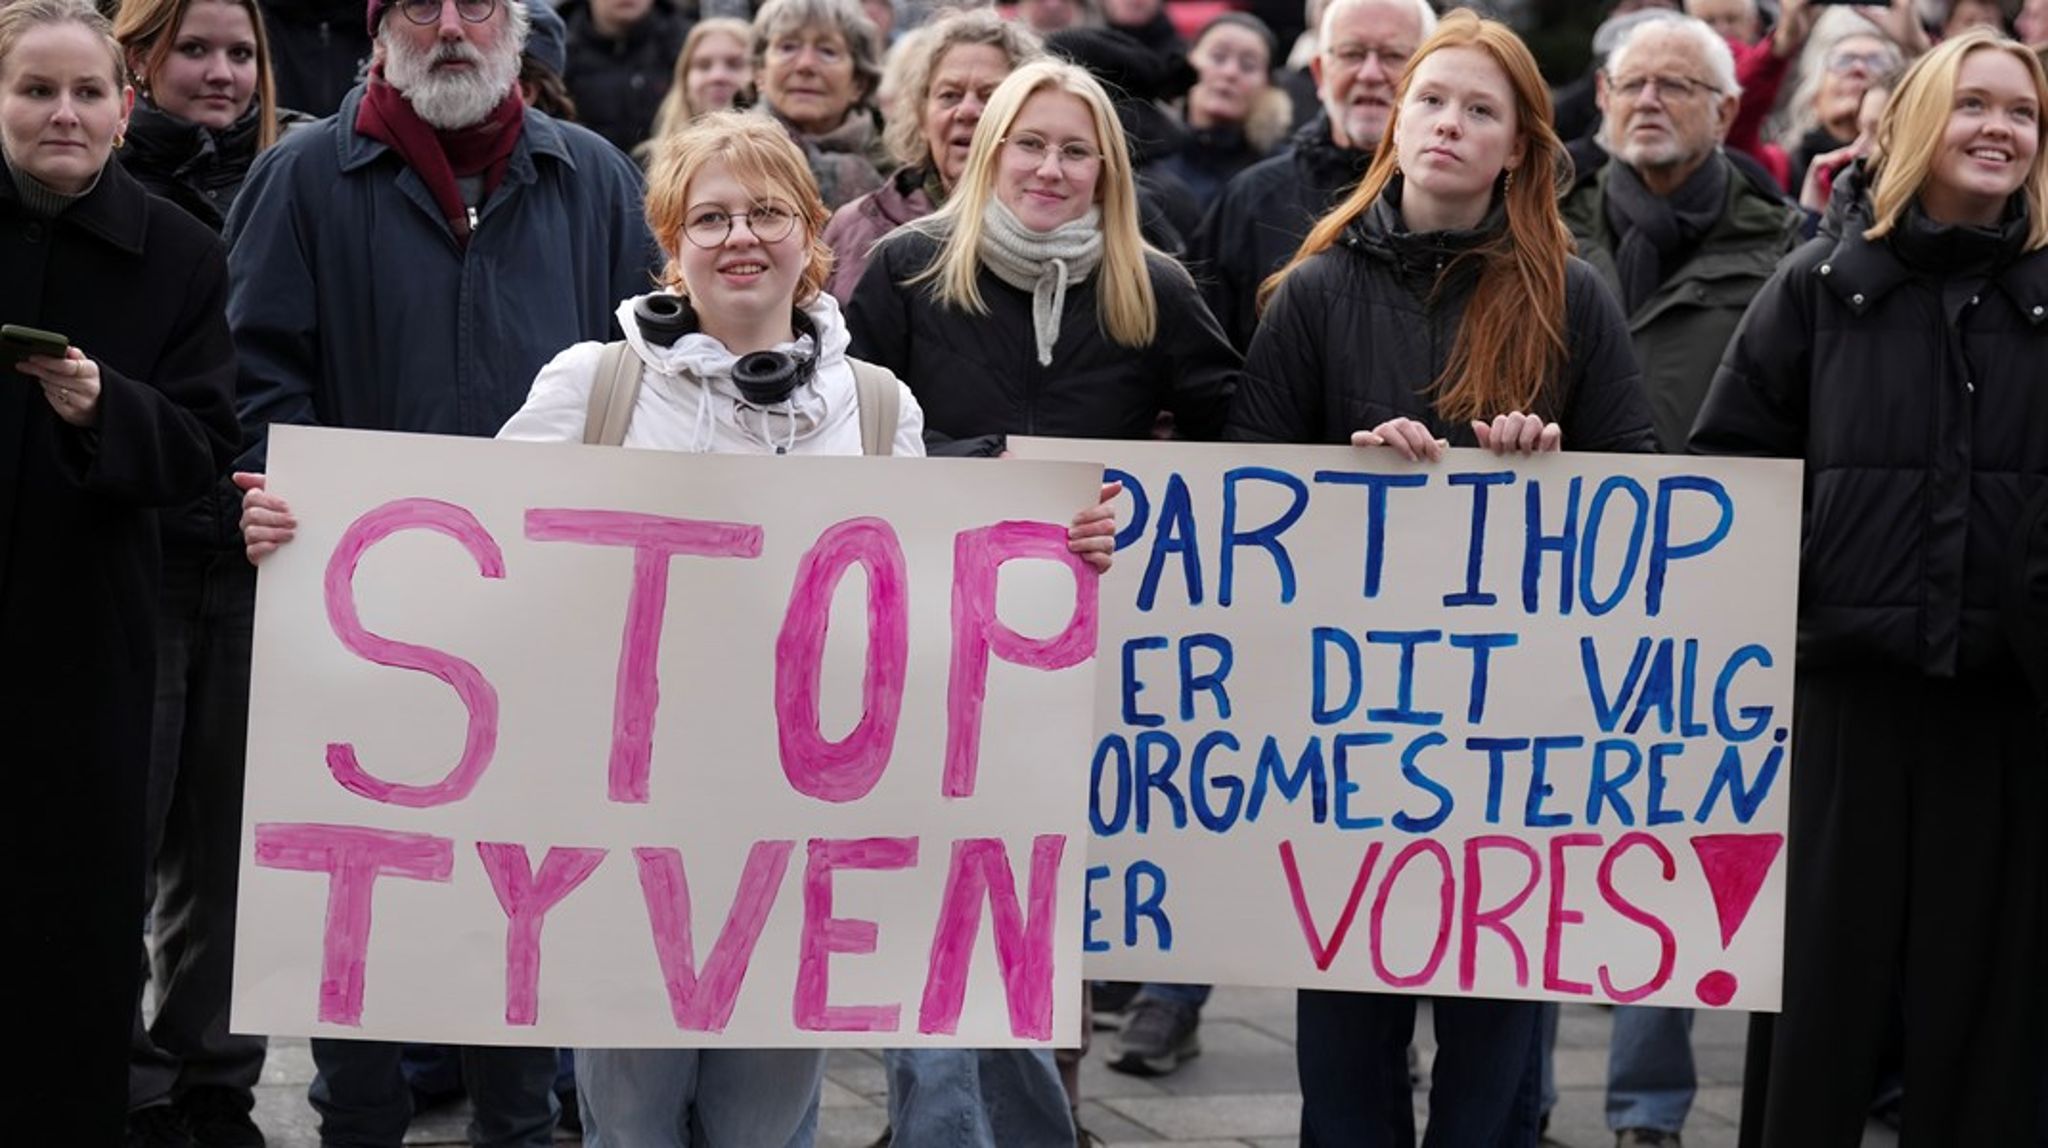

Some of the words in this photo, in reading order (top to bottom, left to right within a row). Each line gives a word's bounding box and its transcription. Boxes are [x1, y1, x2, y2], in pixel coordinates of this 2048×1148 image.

[324, 497, 1100, 803] STOP
[1121, 633, 1233, 727] ER
[1311, 626, 1519, 726] DIT
[1580, 636, 1788, 743] VALG.
[1089, 730, 1785, 837] ORGMESTEREN
[254, 822, 1067, 1042] TYVEN
[1278, 831, 1785, 1007] VORES!
